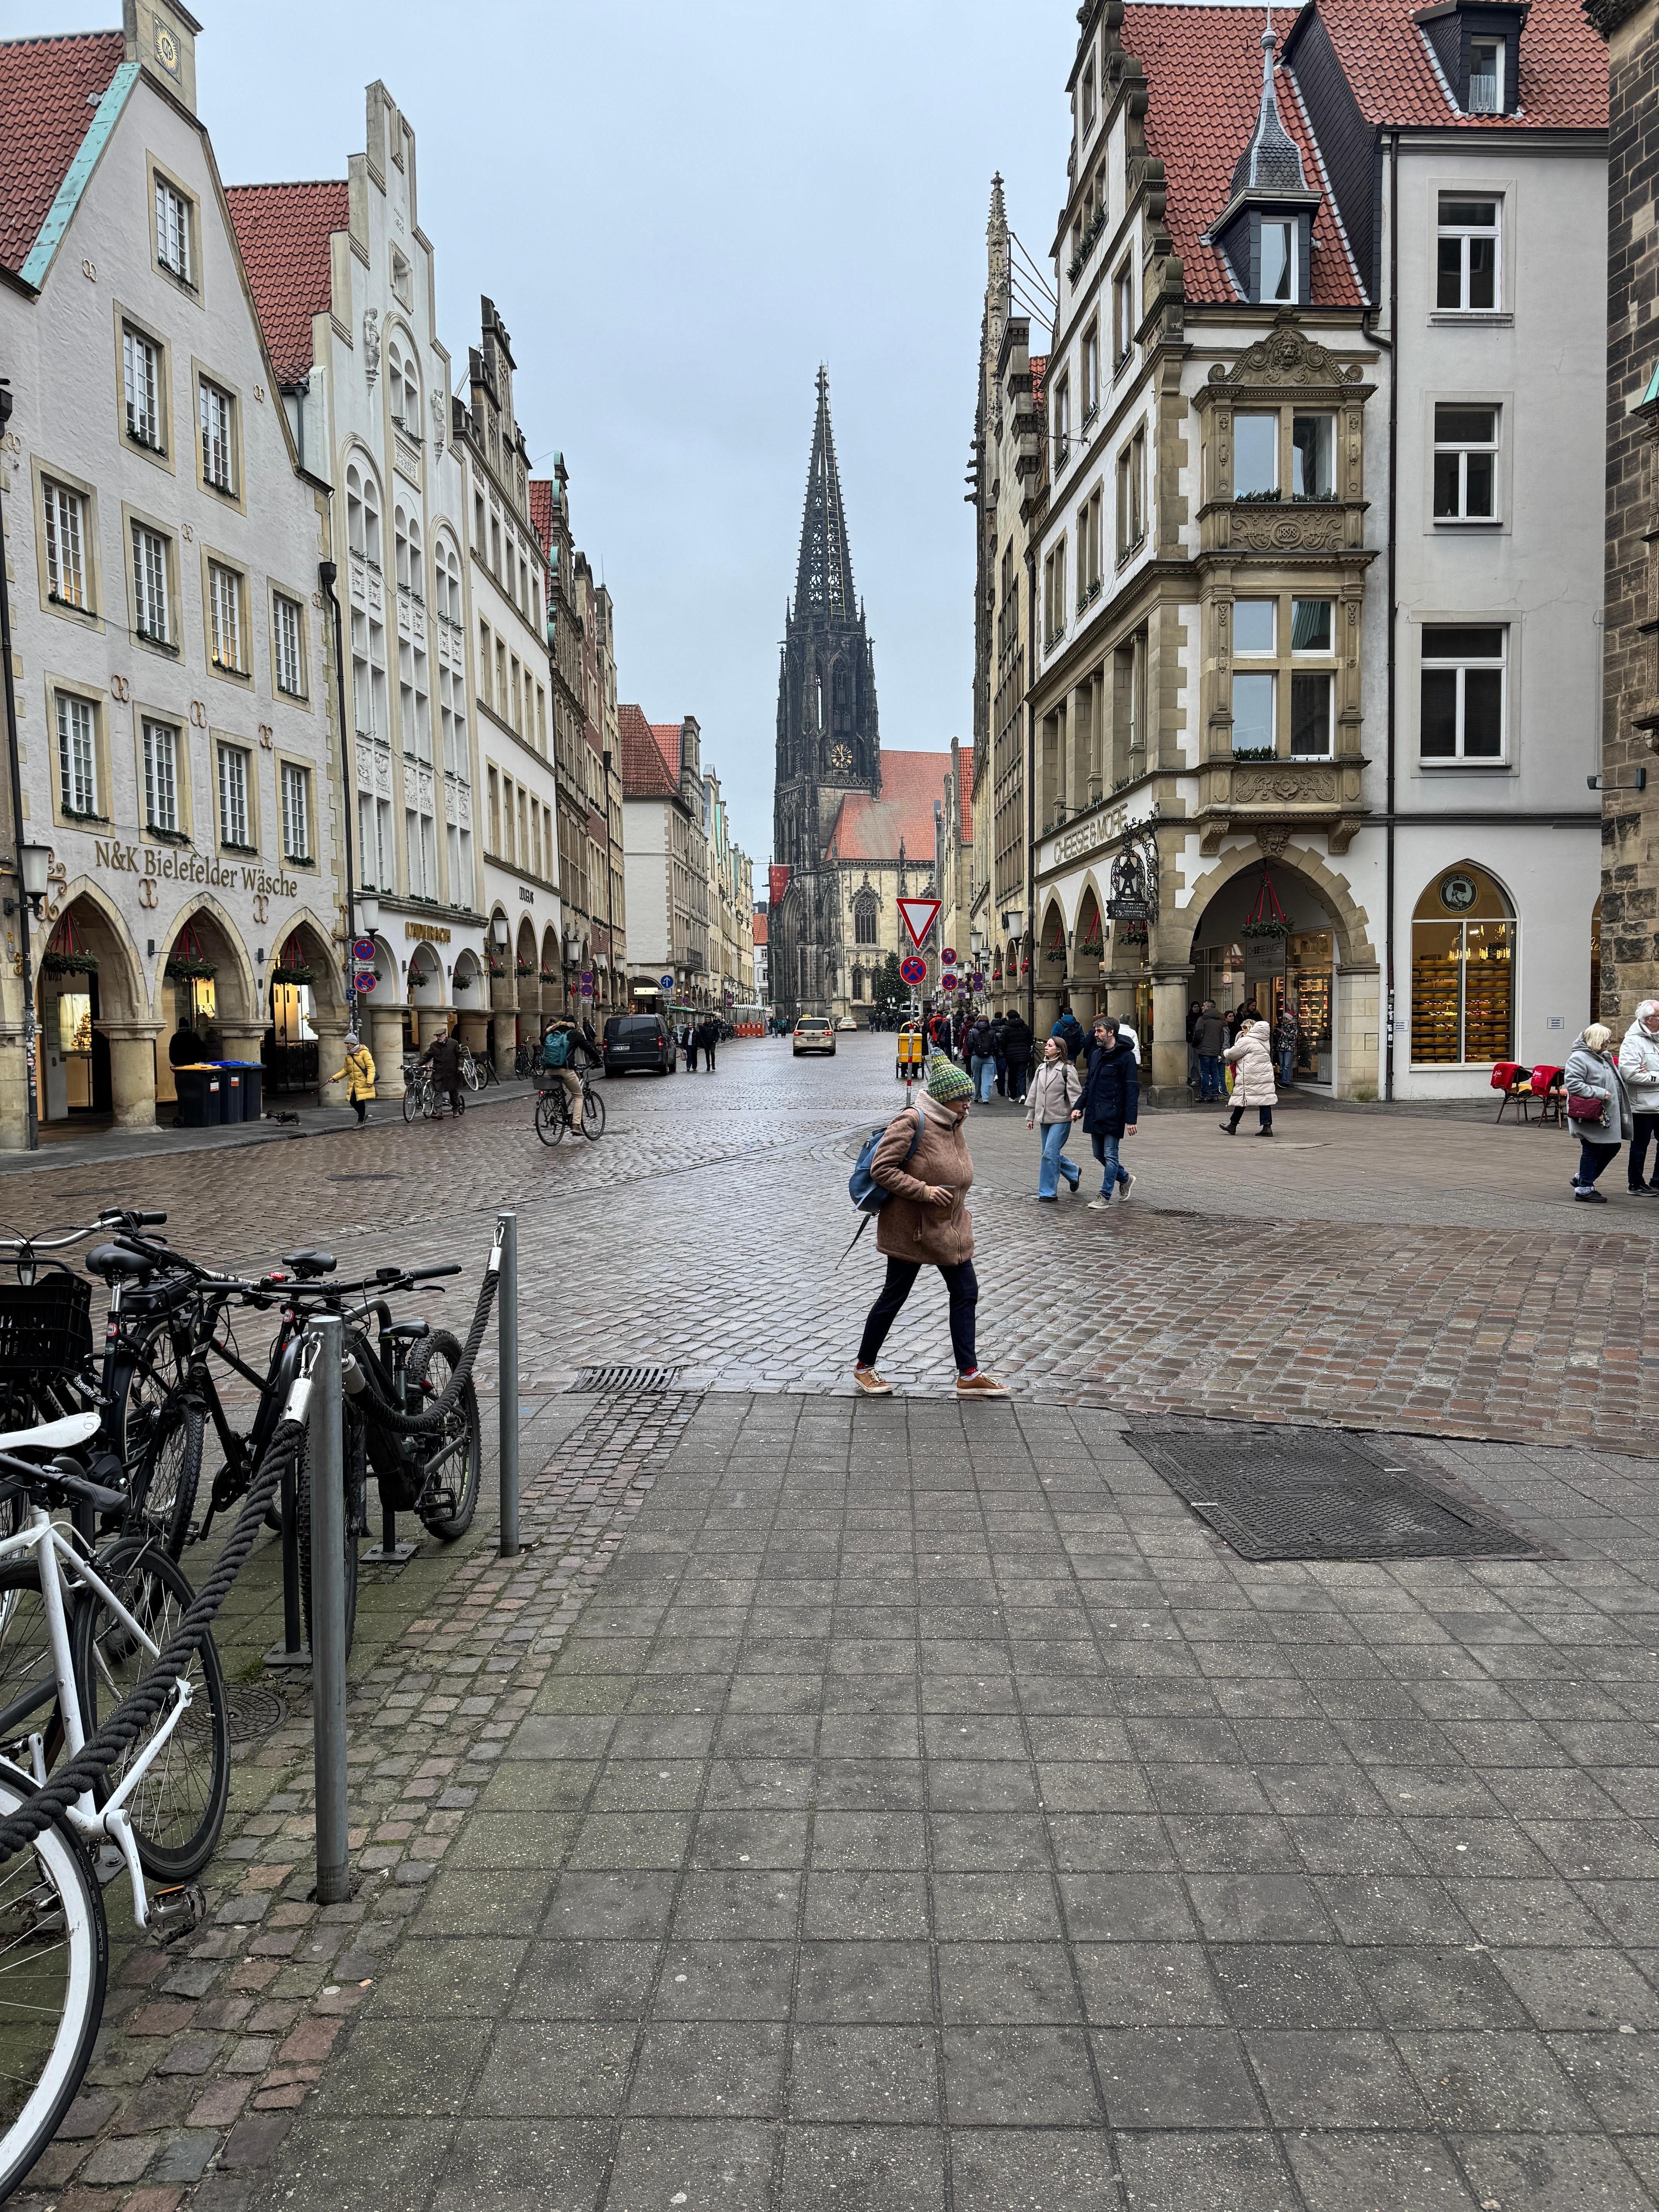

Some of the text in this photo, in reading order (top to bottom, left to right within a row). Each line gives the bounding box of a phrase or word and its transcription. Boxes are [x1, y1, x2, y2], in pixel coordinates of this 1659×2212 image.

[1279, 527, 1297, 538] 1898
[1054, 824, 1089, 864] CHEESE
[1097, 802, 1128, 843] MORE
[95, 840, 297, 897] N&K Bielefelder Wäsche
[1443, 876, 1474, 889] HENRI WILLIG
[76, 1849, 97, 1905] SCHWALBE
[94, 1908, 103, 1951] LUGANO
